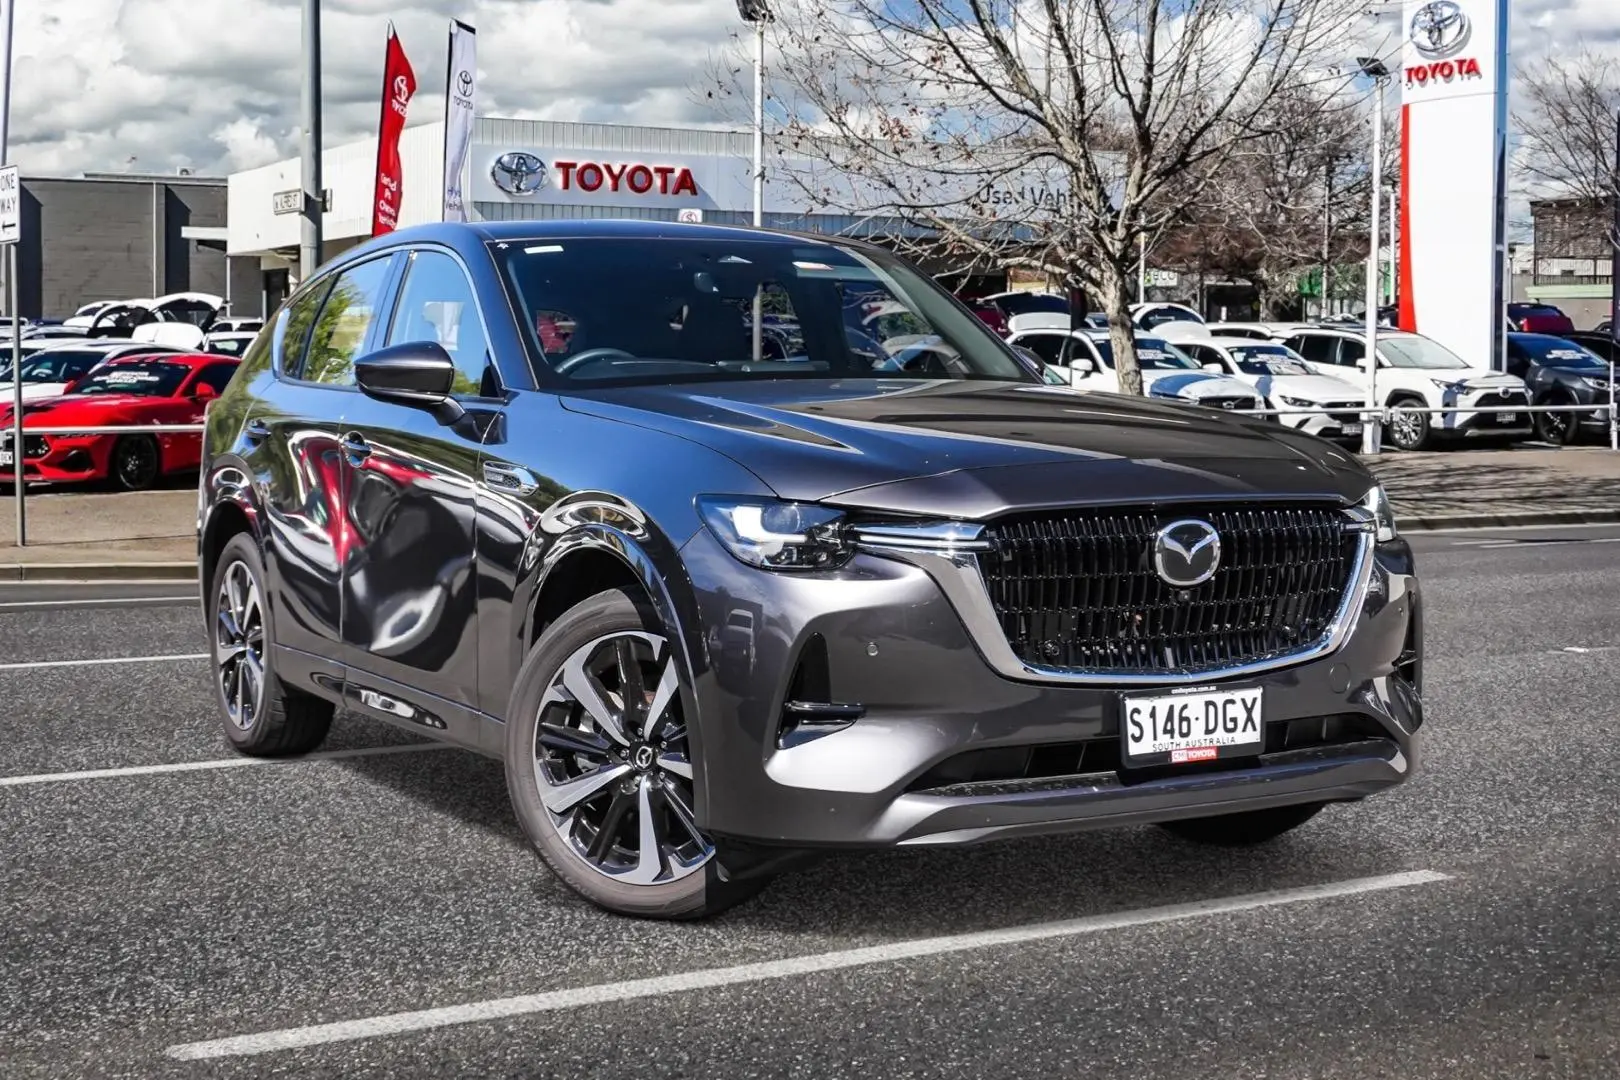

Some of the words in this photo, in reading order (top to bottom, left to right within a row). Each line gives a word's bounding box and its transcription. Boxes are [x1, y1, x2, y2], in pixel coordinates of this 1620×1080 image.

[1404, 58, 1480, 82] TOYOTA
[555, 161, 698, 196] TOYOTA
[0, 196, 16, 214] WAY
[1152, 741, 1181, 752] SOUTH
[1185, 737, 1236, 748] AUSTRALIA
[1188, 748, 1216, 759] TOYOTA
